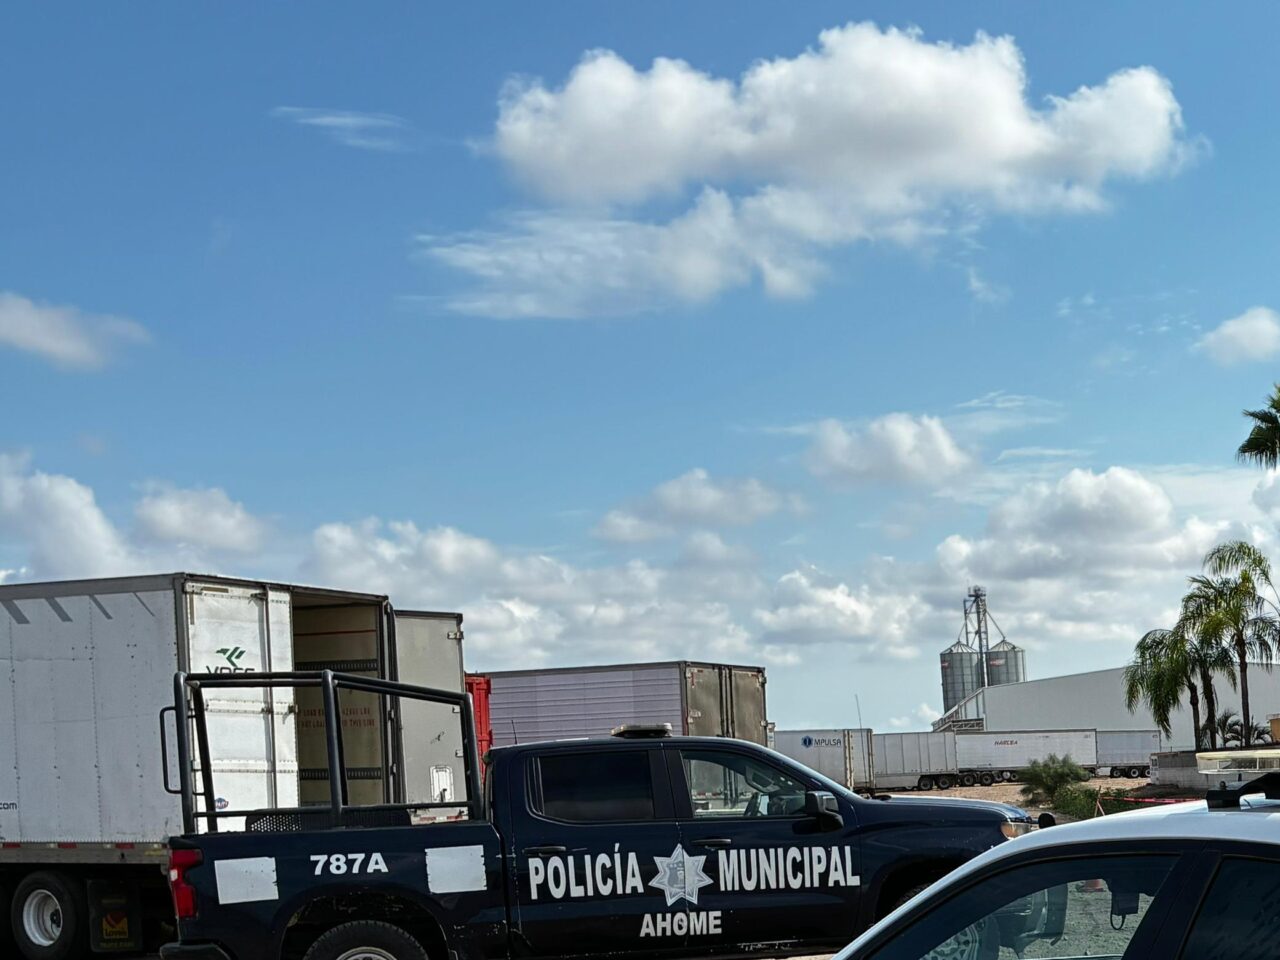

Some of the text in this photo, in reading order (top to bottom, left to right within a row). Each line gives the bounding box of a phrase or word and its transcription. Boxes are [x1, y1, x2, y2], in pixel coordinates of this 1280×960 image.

[310, 853, 388, 875] 787A
[528, 843, 860, 900] POLICÍA MUNICIPAL
[639, 910, 722, 937] AHOME
